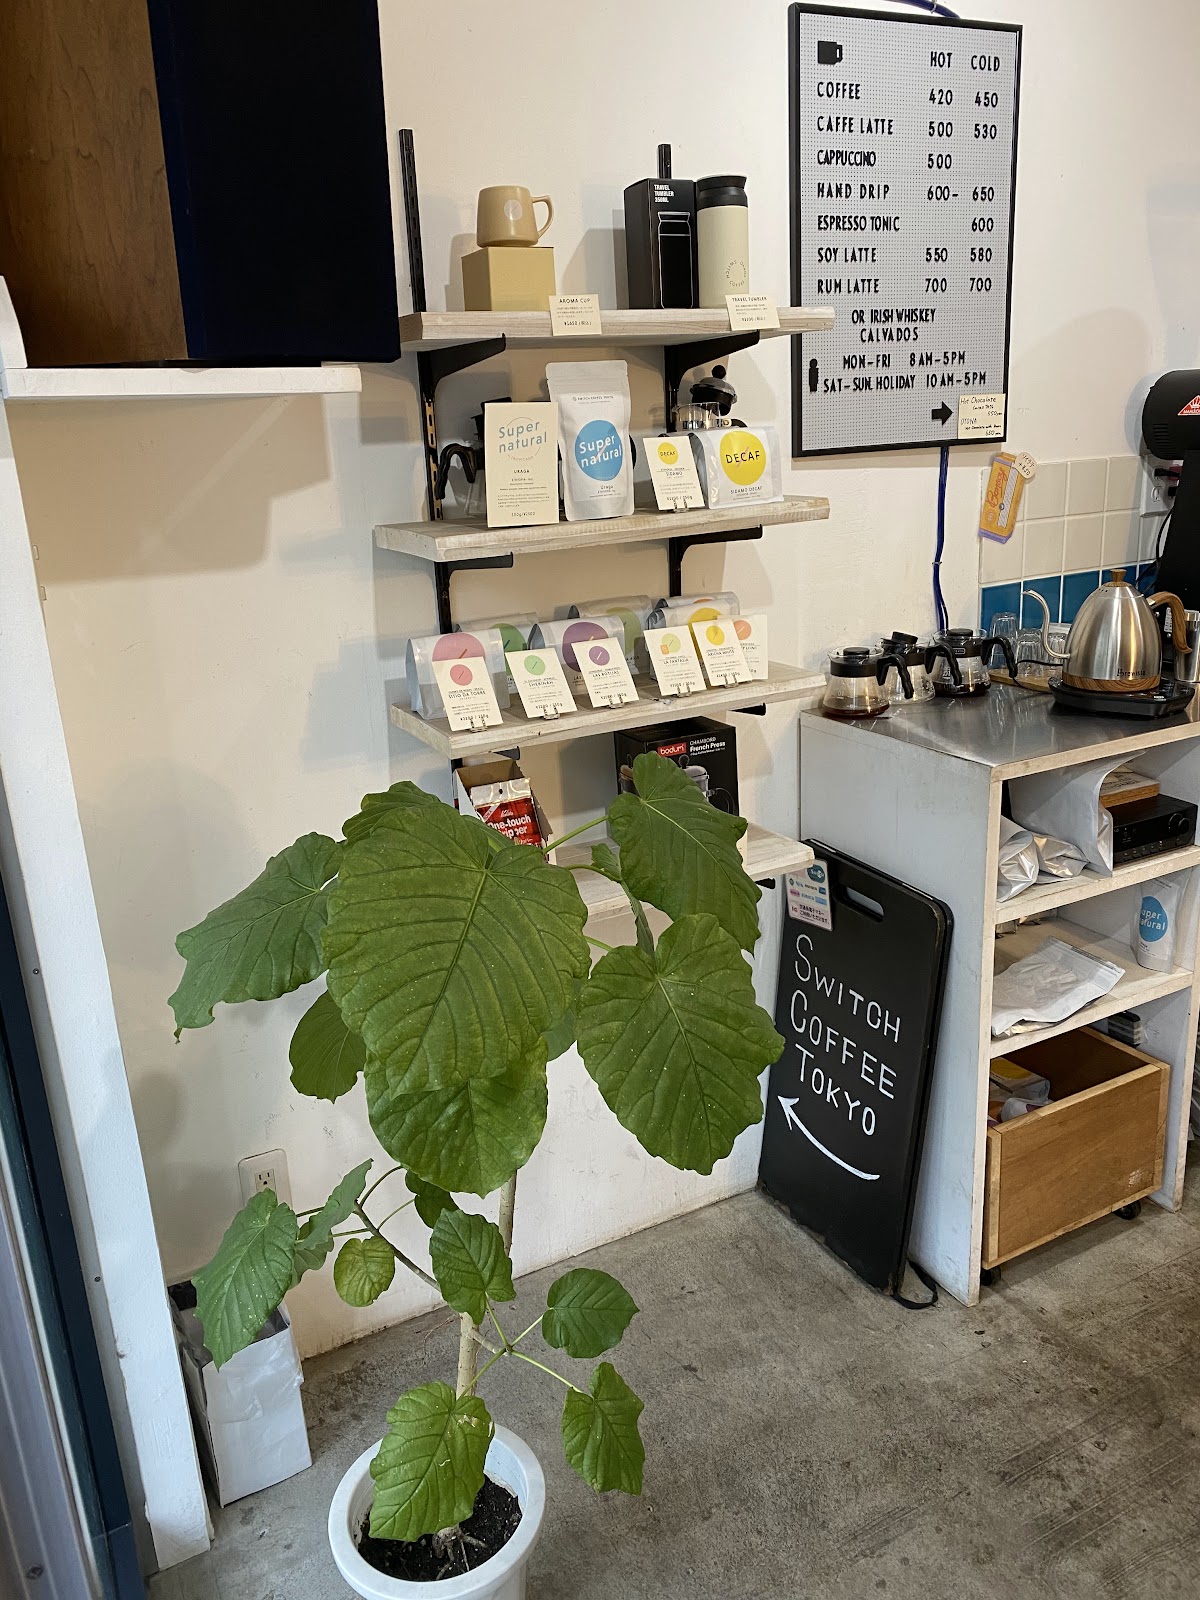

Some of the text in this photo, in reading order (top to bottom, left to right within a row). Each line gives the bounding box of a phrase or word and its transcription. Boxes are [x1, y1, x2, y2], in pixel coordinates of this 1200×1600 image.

[930, 51, 1000, 72] HOT COLD
[817, 82, 999, 108] COFFEE 420 450
[817, 116, 998, 139] CAFFE LATTE 500 530
[817, 150, 952, 169] CAPPUCCINO 500
[817, 183, 852, 199] HAND
[859, 184, 890, 200] DRIP
[972, 187, 995, 202] 650
[817, 215, 994, 233] ESPRESSO TONIC 600
[817, 247, 992, 263] SOY LATTE 550 580
[817, 277, 992, 294] RUM LATTE 700 700
[851, 308, 936, 324] OR IRISH WHISKEY
[860, 327, 919, 342] CALVADOS
[876, 374, 916, 390] HOLIDAY
[498, 420, 541, 440] Super
[498, 431, 548, 454] natural
[579, 435, 615, 454] Super
[581, 445, 622, 468] natural
[725, 450, 761, 464] DECAF
[660, 743, 685, 755] bodum
[689, 736, 717, 746] CHAMBORD
[689, 742, 710, 753] French
[710, 741, 726, 749] Press
[1141, 907, 1162, 920] uper
[1140, 917, 1166, 931] atural
[795, 933, 901, 1043] SWITCH
[790, 989, 897, 1100] COFFEE
[795, 1043, 876, 1136] TOKYO
